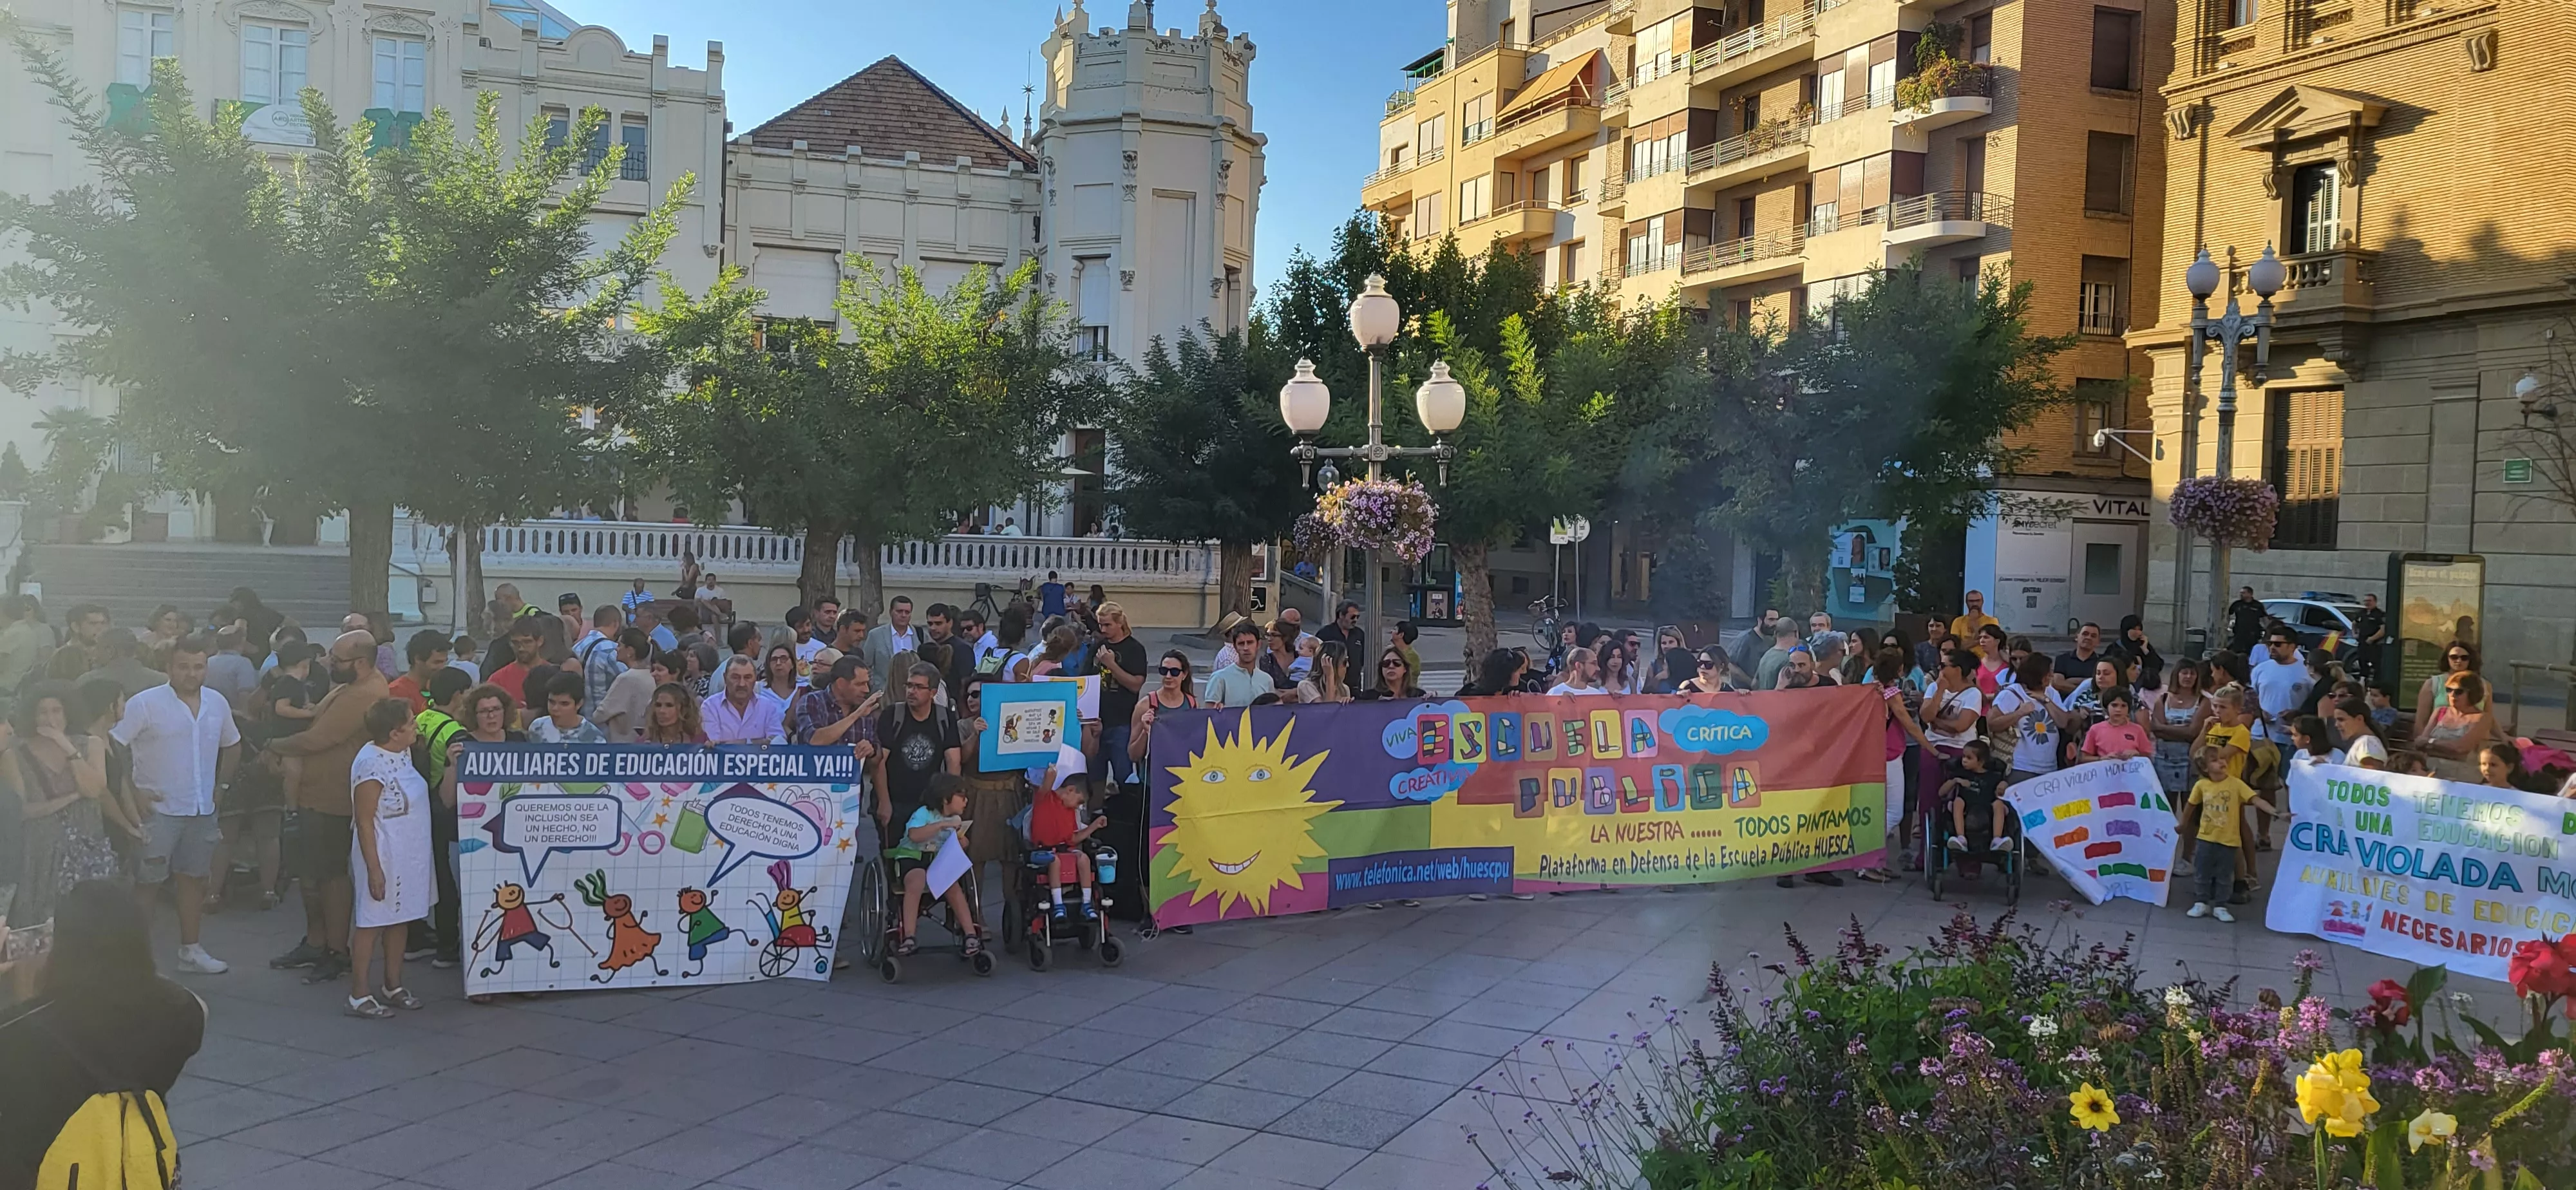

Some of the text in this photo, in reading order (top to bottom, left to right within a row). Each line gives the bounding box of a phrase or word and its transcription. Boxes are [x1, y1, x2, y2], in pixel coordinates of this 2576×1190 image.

[2094, 500, 2150, 516] VITAL
[1387, 727, 1417, 748] VIVA
[1421, 716, 1656, 760] ESCUELA
[1687, 721, 1753, 742] CRÍTICA
[464, 748, 854, 778] AUXILIARES DE EDUCACIÓN ESPECIAL YA!!!
[1398, 766, 1471, 795] CREATIVA
[2034, 778, 2061, 798] CRA
[515, 803, 609, 812] QUEREMOS QUE LA
[525, 812, 598, 822] INCLUSIÓN SEA
[2327, 779, 2392, 808] TODOS
[2413, 791, 2525, 827] TENEMOS
[542, 824, 580, 834] HECHO,
[582, 824, 597, 833] NO
[728, 814, 798, 841] DERECHO A UNA
[730, 803, 804, 832] TODOS TENEMOS
[1591, 824, 1611, 844] LA
[1616, 820, 1685, 845] NUESTRA
[1734, 814, 1790, 839] TODOS
[1796, 806, 1872, 835] PINTAMOS
[524, 834, 597, 844] UN DERECHO!!!
[719, 822, 800, 852] EDUCACIÓN DIGNA
[2355, 810, 2394, 837] UNA
[2418, 818, 2559, 861] EDUCACION
[1539, 834, 1856, 879] Plataforma en Defensa de la Escuela Pública HUESCA
[2291, 822, 2354, 860] CRA
[2354, 836, 2524, 893] VIOLADA
[2425, 890, 2456, 915] DE
